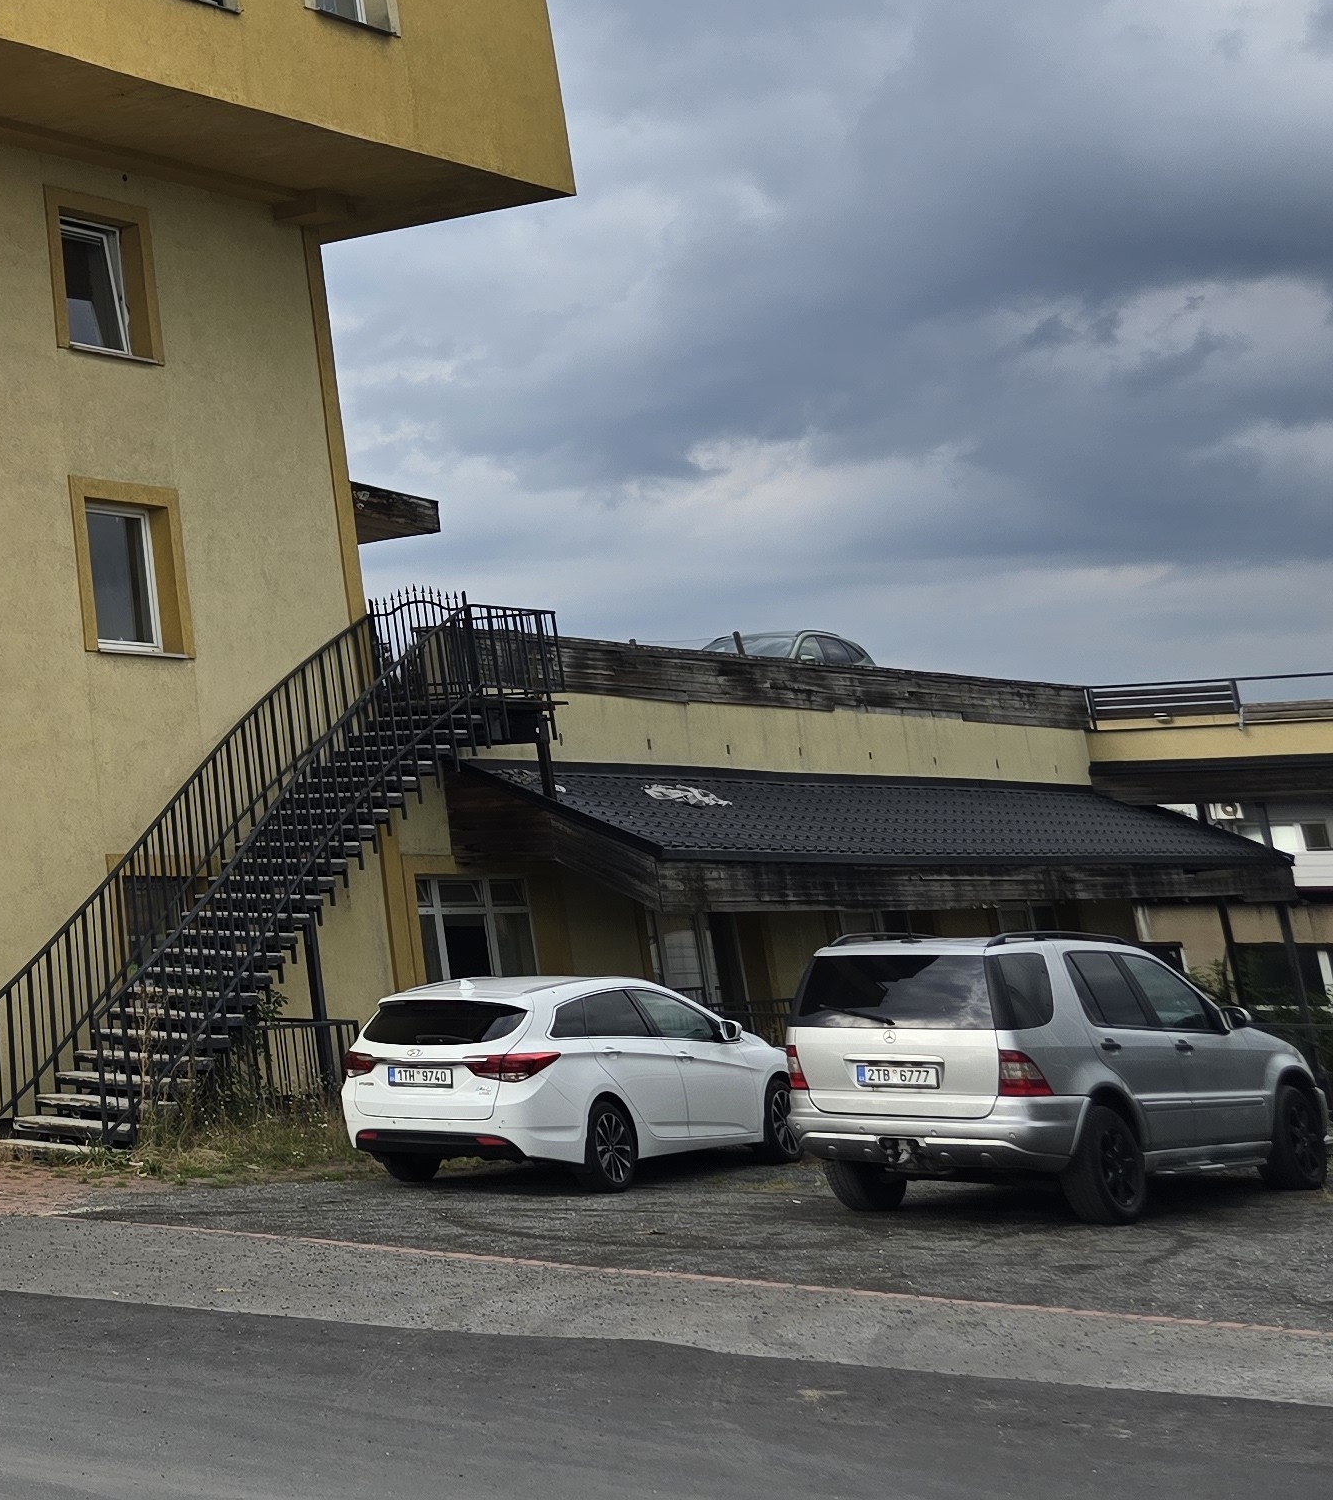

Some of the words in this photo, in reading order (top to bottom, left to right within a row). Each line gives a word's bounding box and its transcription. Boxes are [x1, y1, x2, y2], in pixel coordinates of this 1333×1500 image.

[397, 1069, 415, 1082] 1TH
[422, 1070, 447, 1083] 9740
[867, 1069, 890, 1082] 2TB
[900, 1069, 930, 1083] 6777
